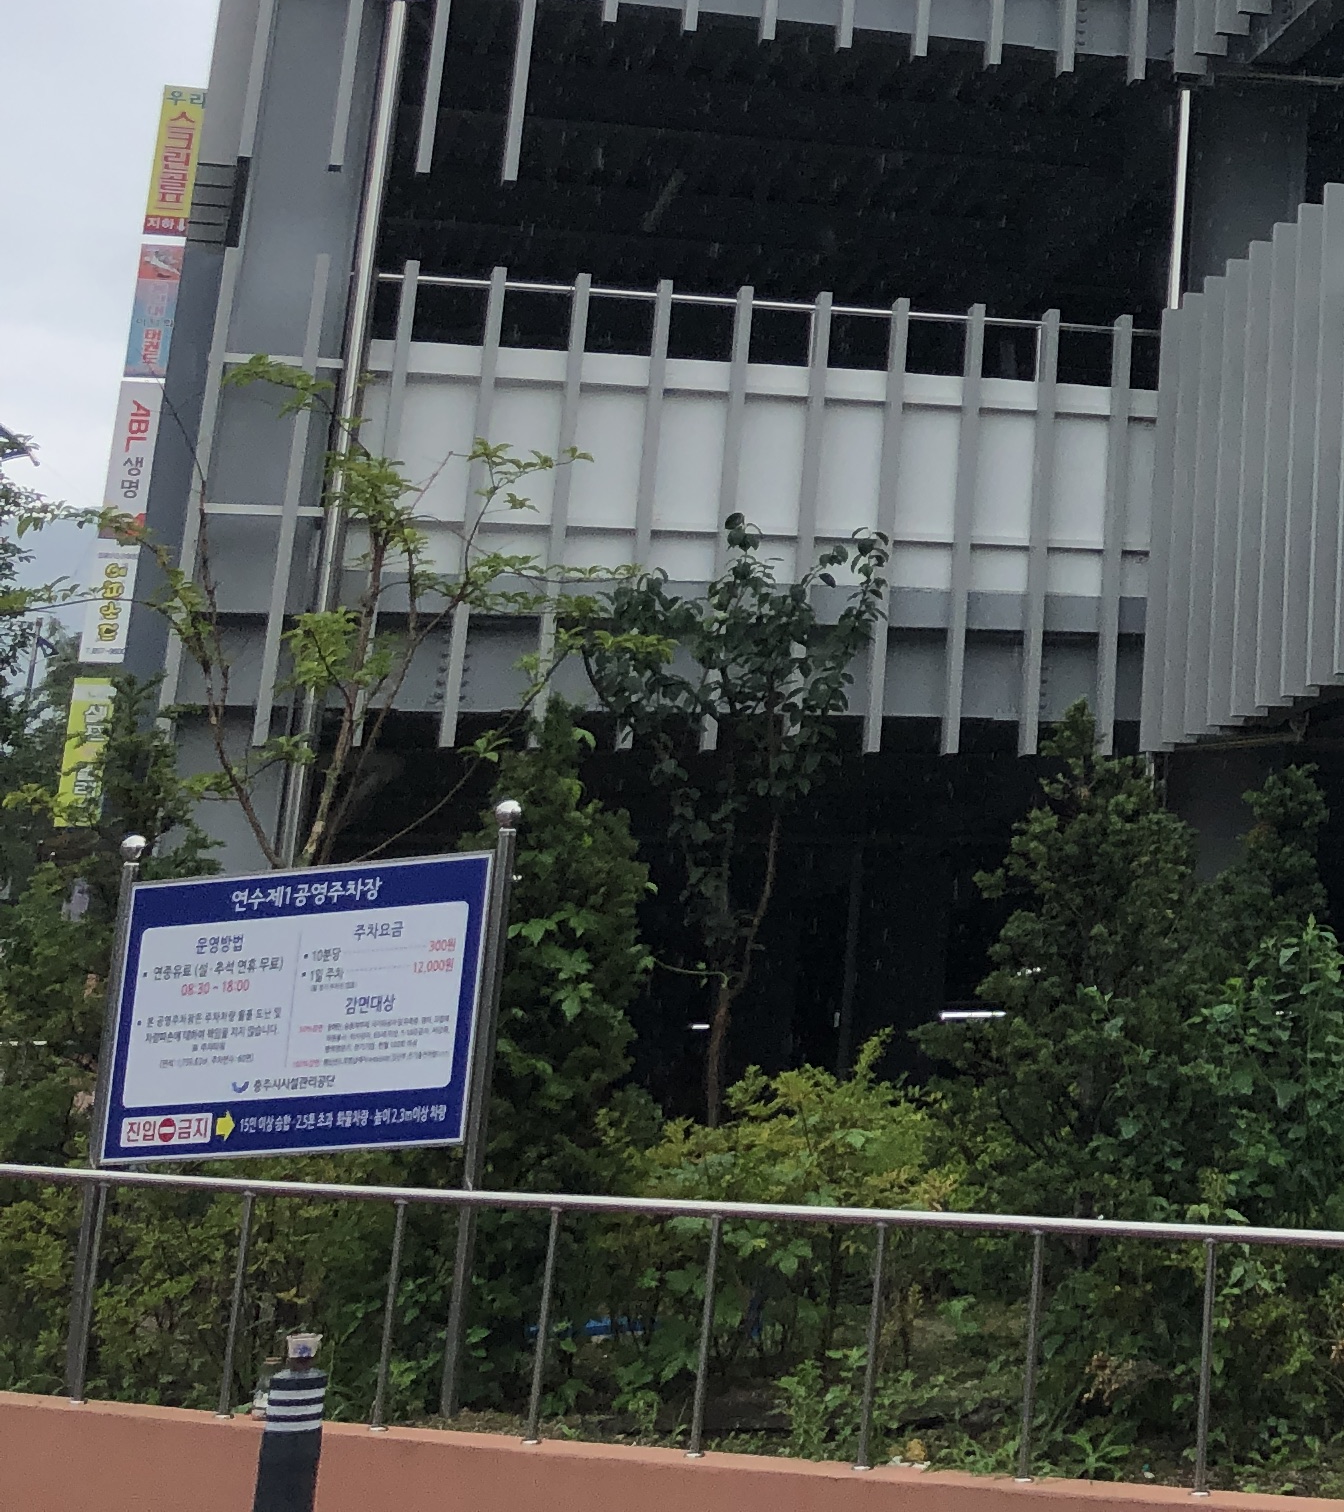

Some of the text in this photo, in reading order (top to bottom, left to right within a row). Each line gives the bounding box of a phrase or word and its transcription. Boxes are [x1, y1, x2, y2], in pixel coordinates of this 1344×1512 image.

[120, 399, 151, 499] ABL 생명
[230, 877, 383, 913] 연수제1공영주차장
[354, 921, 405, 941] 주차요금
[195, 934, 245, 955] 운영방법
[428, 937, 457, 953] 300원
[345, 994, 396, 1015] 감면대상
[253, 1074, 336, 1093] 충주시시설관리공단
[126, 1117, 209, 1143] 진입 금지
